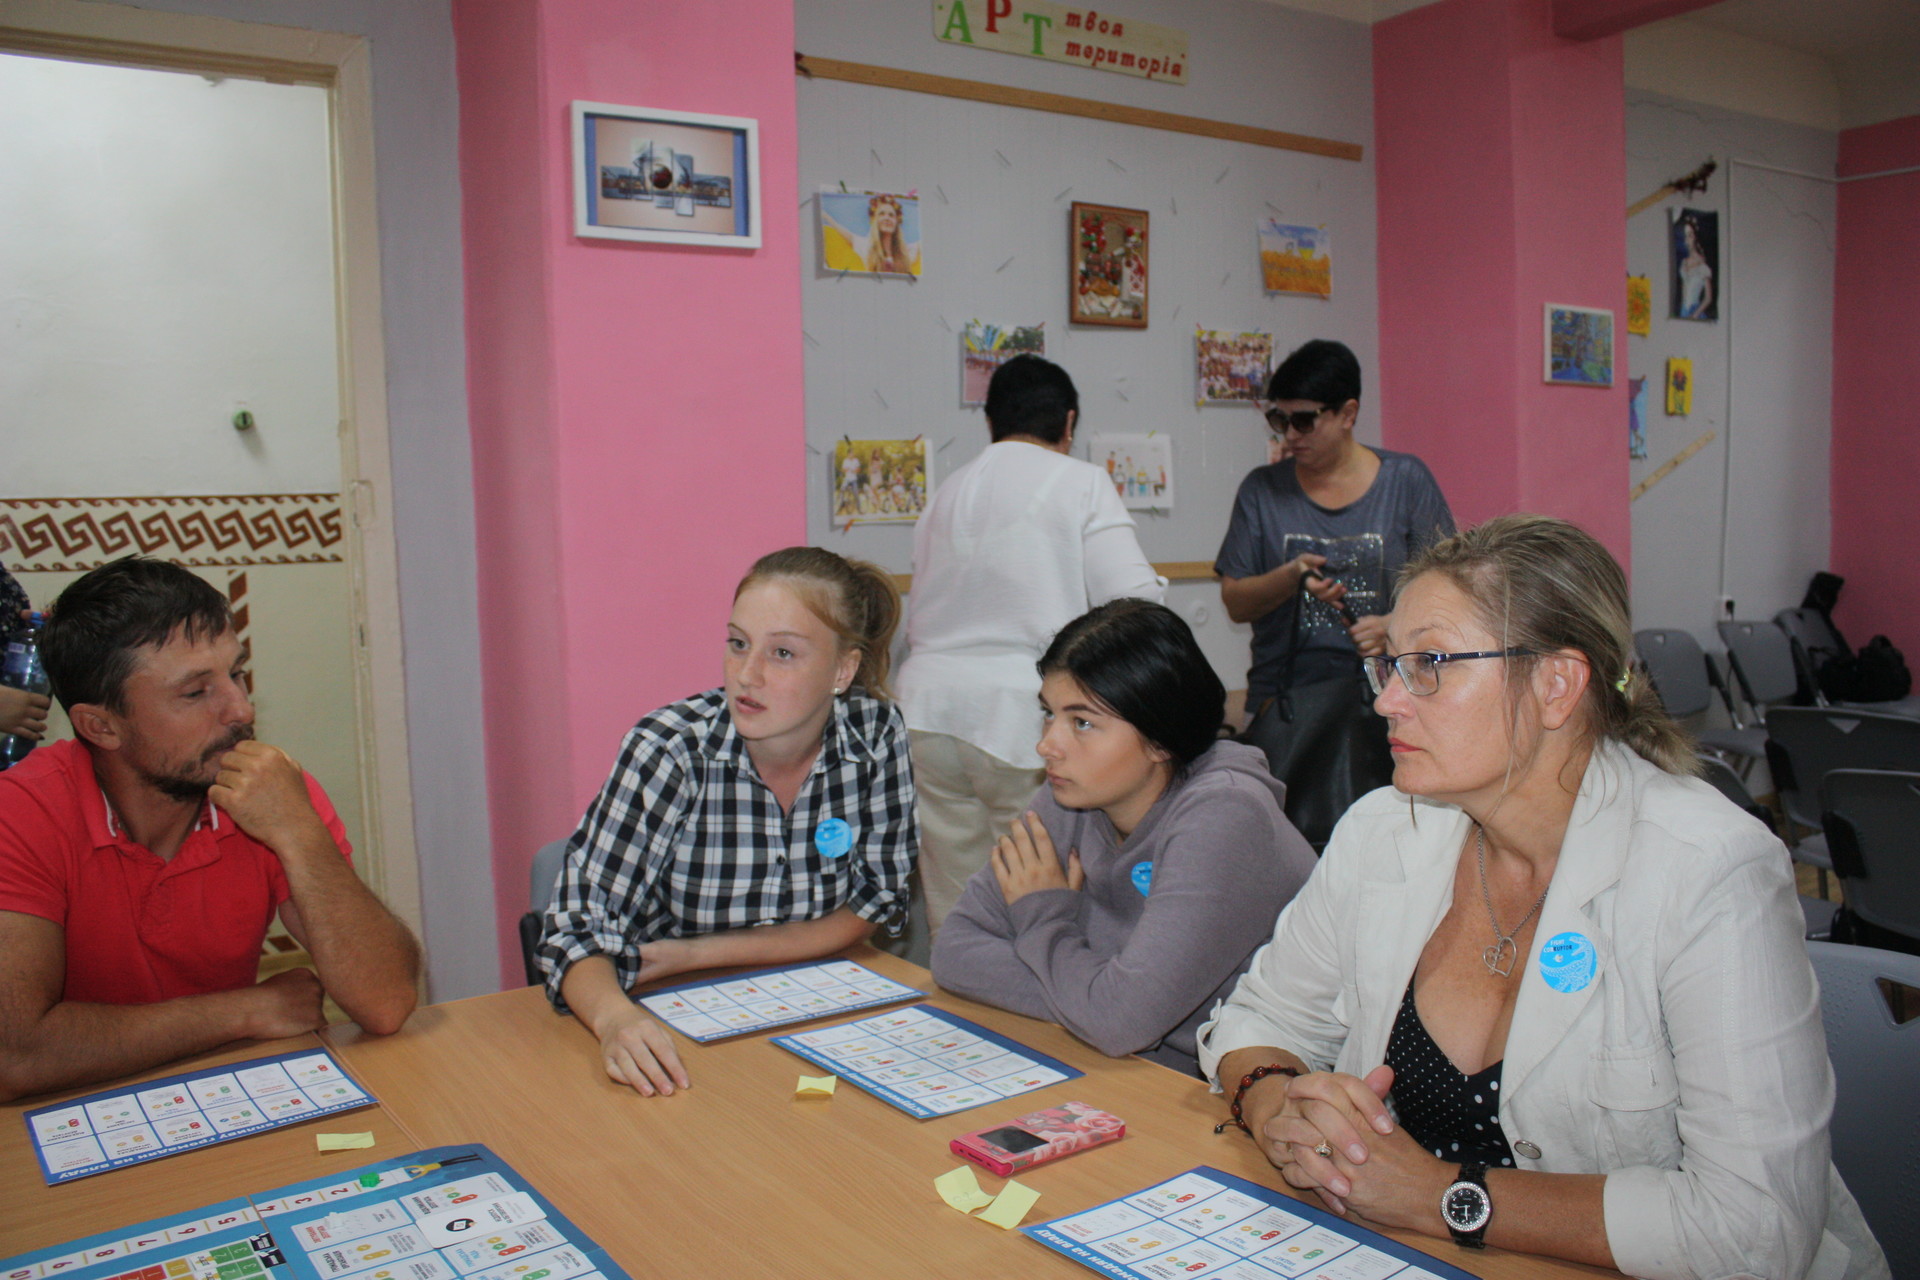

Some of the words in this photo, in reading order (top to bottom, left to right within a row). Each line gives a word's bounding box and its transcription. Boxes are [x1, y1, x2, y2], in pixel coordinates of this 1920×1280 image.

[1065, 11, 1124, 37] твоя
[1065, 41, 1182, 78] територія
[95, 1249, 116, 1258] 8
